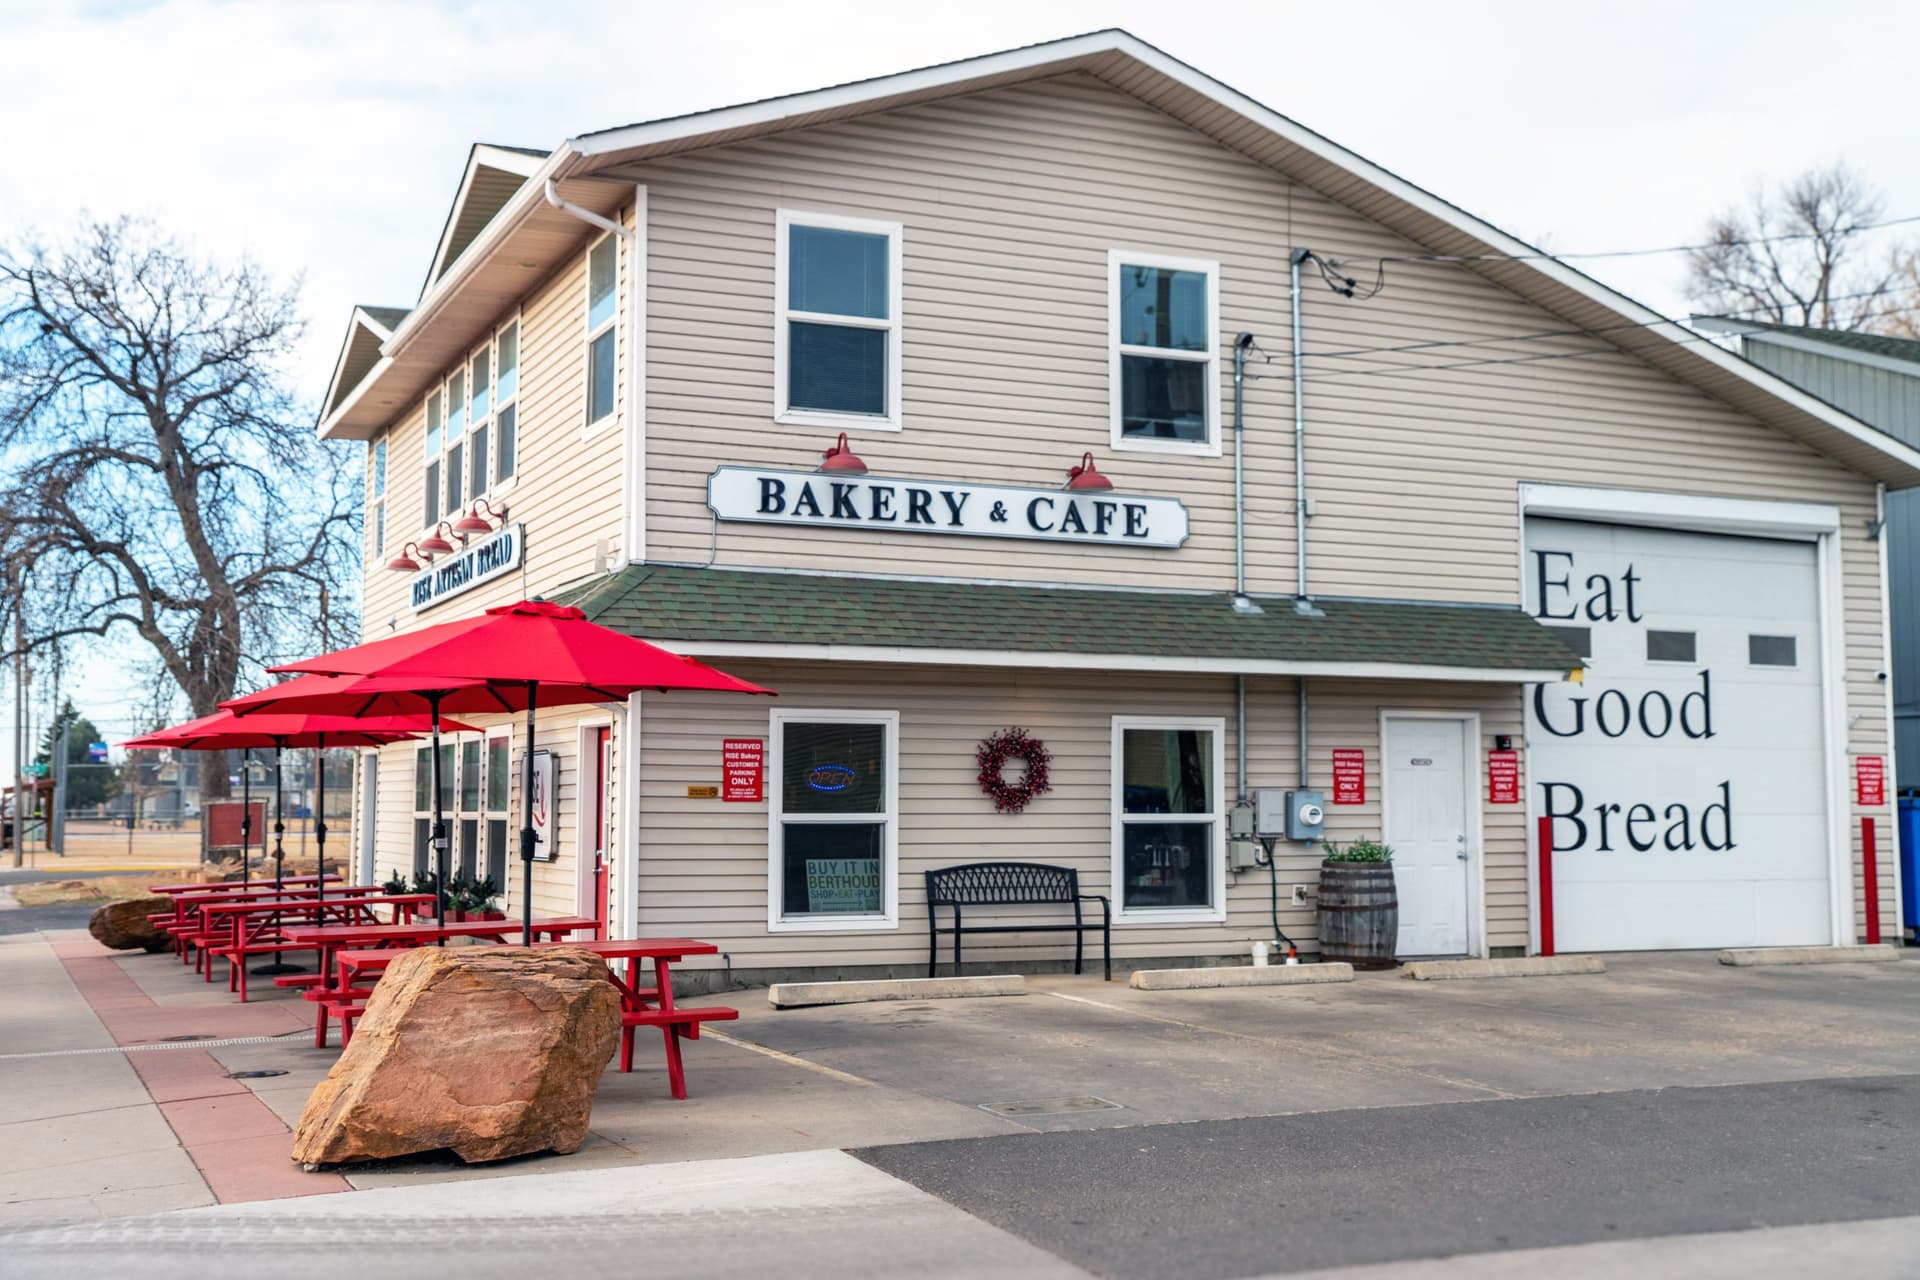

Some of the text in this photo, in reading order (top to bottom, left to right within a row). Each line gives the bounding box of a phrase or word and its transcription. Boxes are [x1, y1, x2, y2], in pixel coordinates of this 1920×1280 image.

[757, 477, 1149, 538] BAKERY & CAFE
[412, 533, 512, 607] RISE ARTISAN BREAD
[1530, 550, 1643, 623] Eat
[1533, 669, 1716, 739] Good
[808, 771, 856, 785] OPEN
[1536, 780, 1737, 852] Bread
[807, 861, 879, 874] BUY IT IN
[808, 875, 880, 889] BERTHOUD
